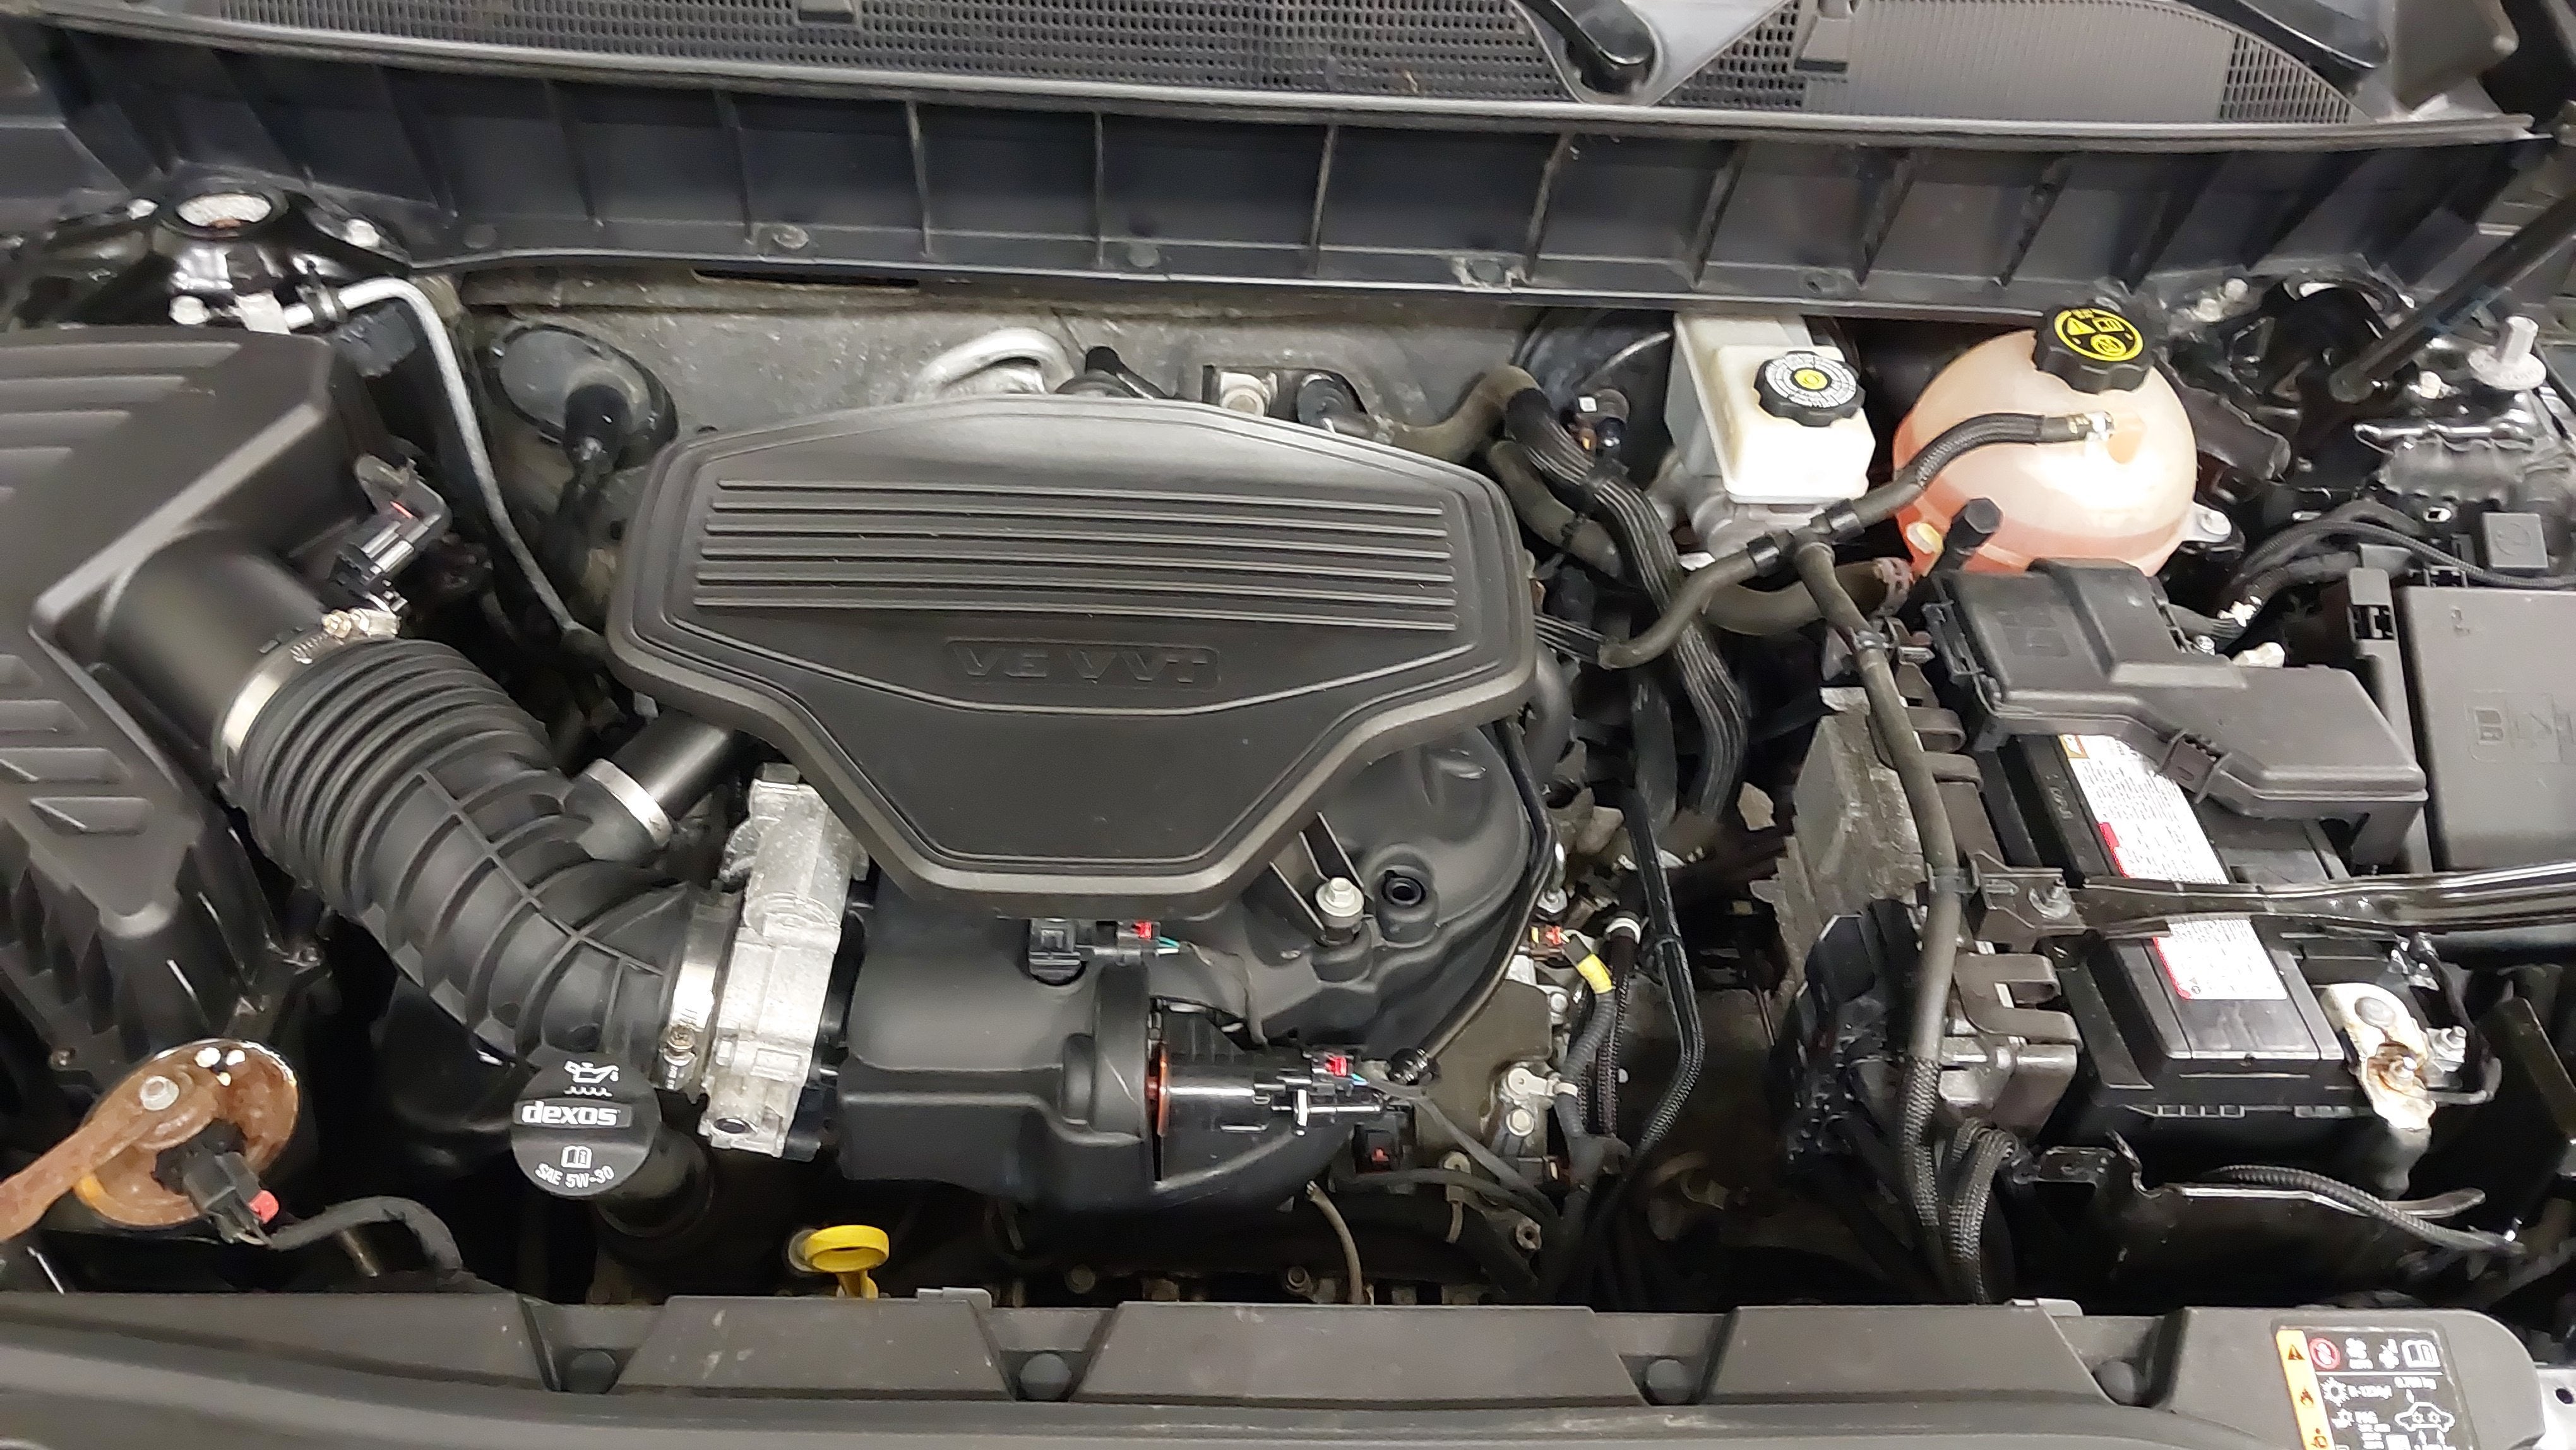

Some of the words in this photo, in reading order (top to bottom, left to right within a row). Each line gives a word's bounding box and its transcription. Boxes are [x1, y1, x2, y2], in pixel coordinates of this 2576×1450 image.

[953, 647, 1048, 678] V6
[1065, 649, 1208, 683] VVT
[522, 1100, 616, 1125] dexos
[535, 1163, 563, 1185] SAE
[565, 1165, 614, 1188] 5W-30
